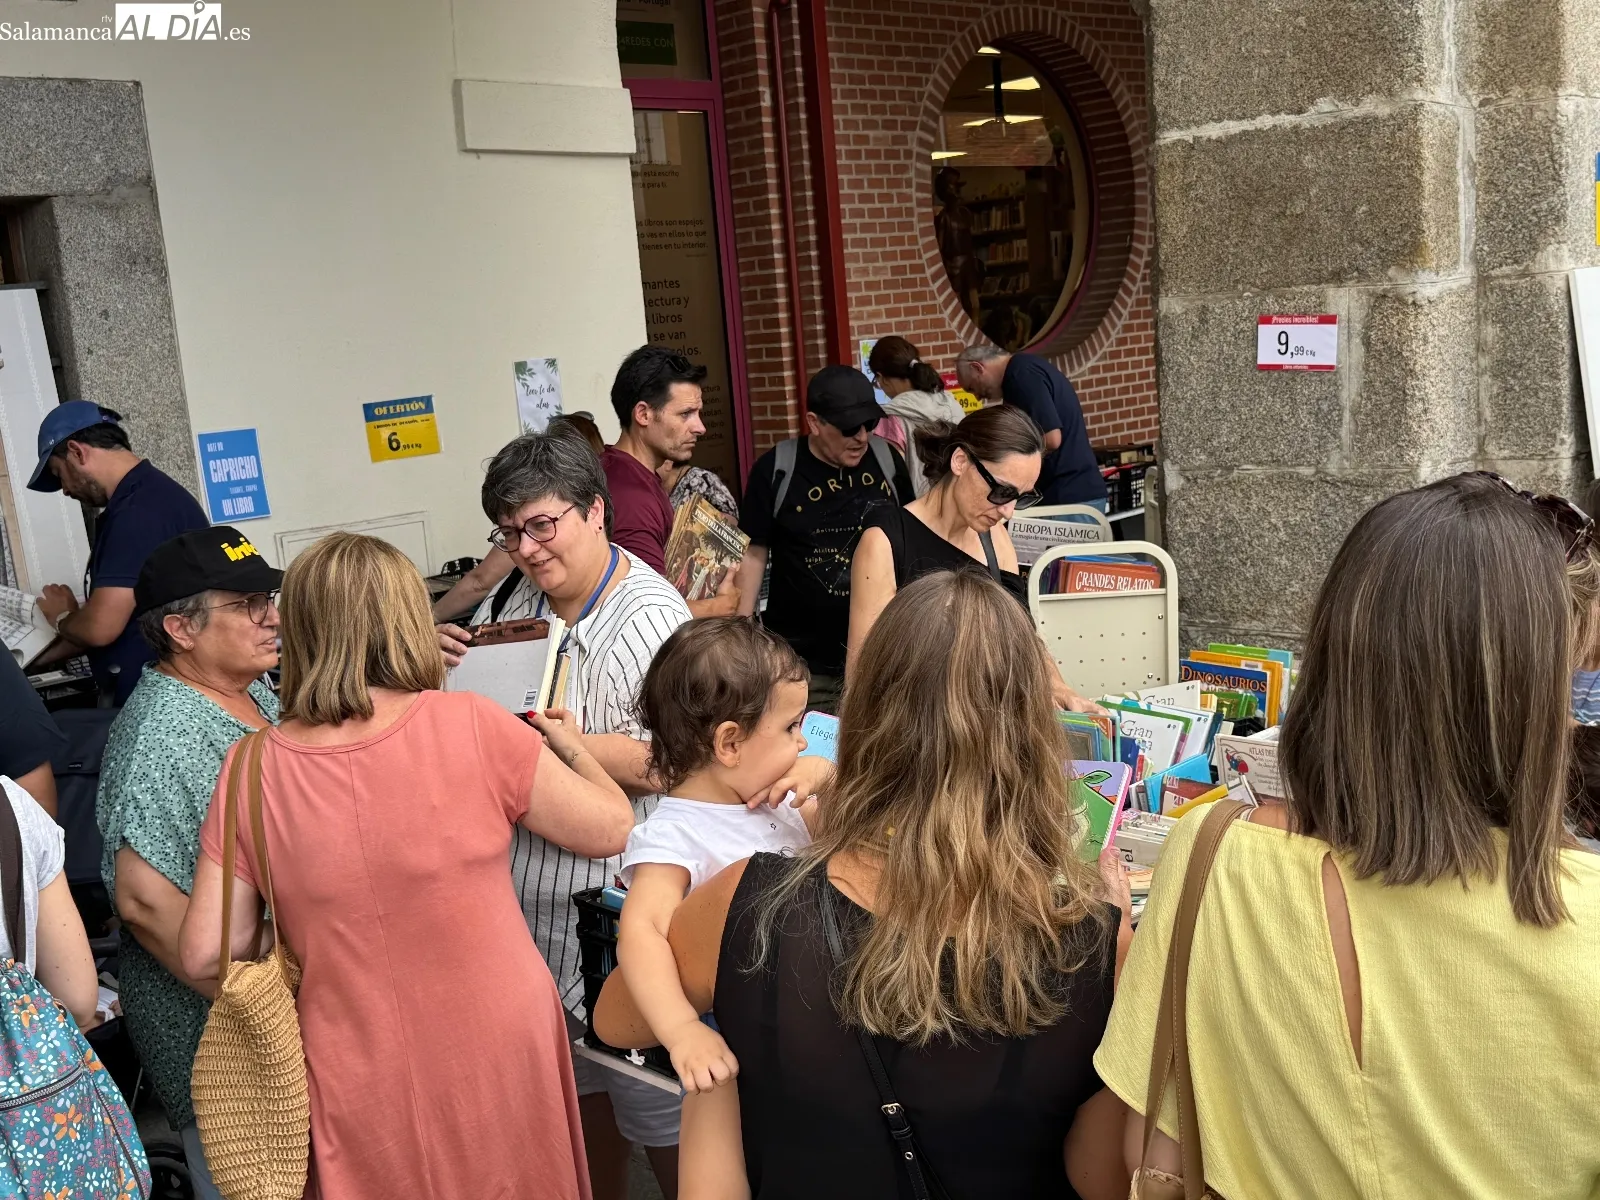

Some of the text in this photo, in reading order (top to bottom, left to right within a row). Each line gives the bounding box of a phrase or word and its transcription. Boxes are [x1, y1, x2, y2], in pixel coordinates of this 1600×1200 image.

[652, 313, 683, 325] libros
[653, 331, 687, 342] se van
[374, 401, 426, 416] OFERTÓN
[209, 455, 259, 483] CAPRICHO
[808, 472, 892, 502] ORION
[222, 496, 255, 517] UN LIBRO
[1012, 522, 1052, 536] EUROPA
[1076, 571, 1154, 591] GRANDES RELATOS
[1181, 665, 1268, 693] DINOSAURIOS
[1120, 720, 1153, 738] Gran
